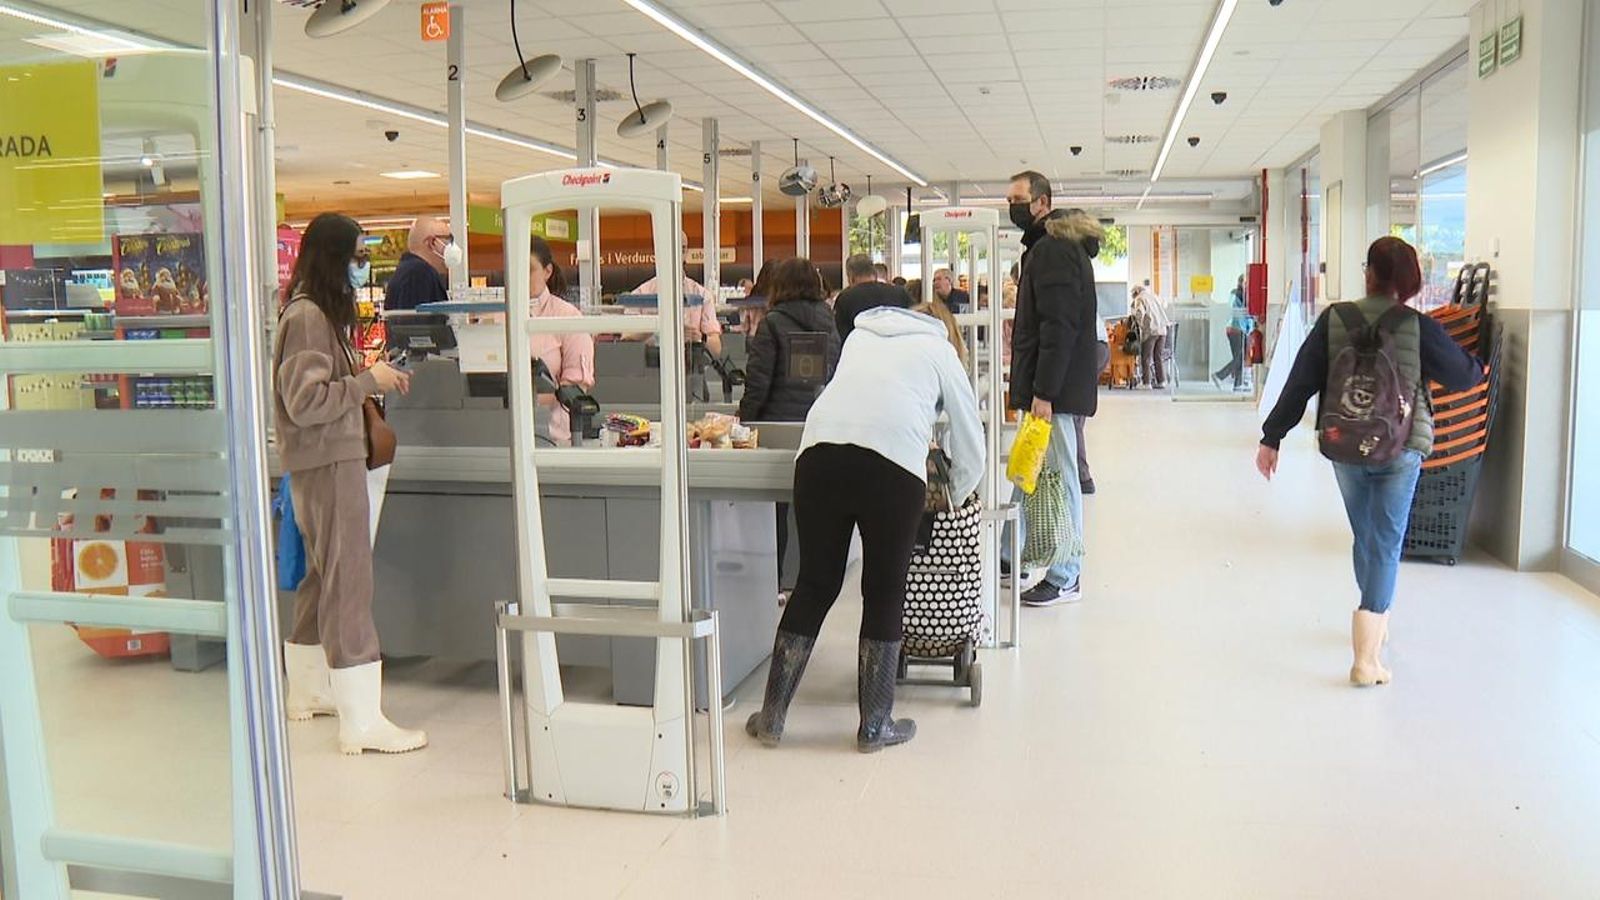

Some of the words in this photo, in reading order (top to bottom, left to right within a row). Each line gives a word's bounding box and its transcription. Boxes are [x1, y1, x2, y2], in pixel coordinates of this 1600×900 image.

[448, 64, 458, 81] 2
[577, 108, 586, 121] 3
[0, 135, 52, 157] ADA
[657, 139, 664, 149] 4
[703, 153, 711, 164] 5
[562, 172, 602, 186] Checkpoint
[752, 172, 760, 181] 6
